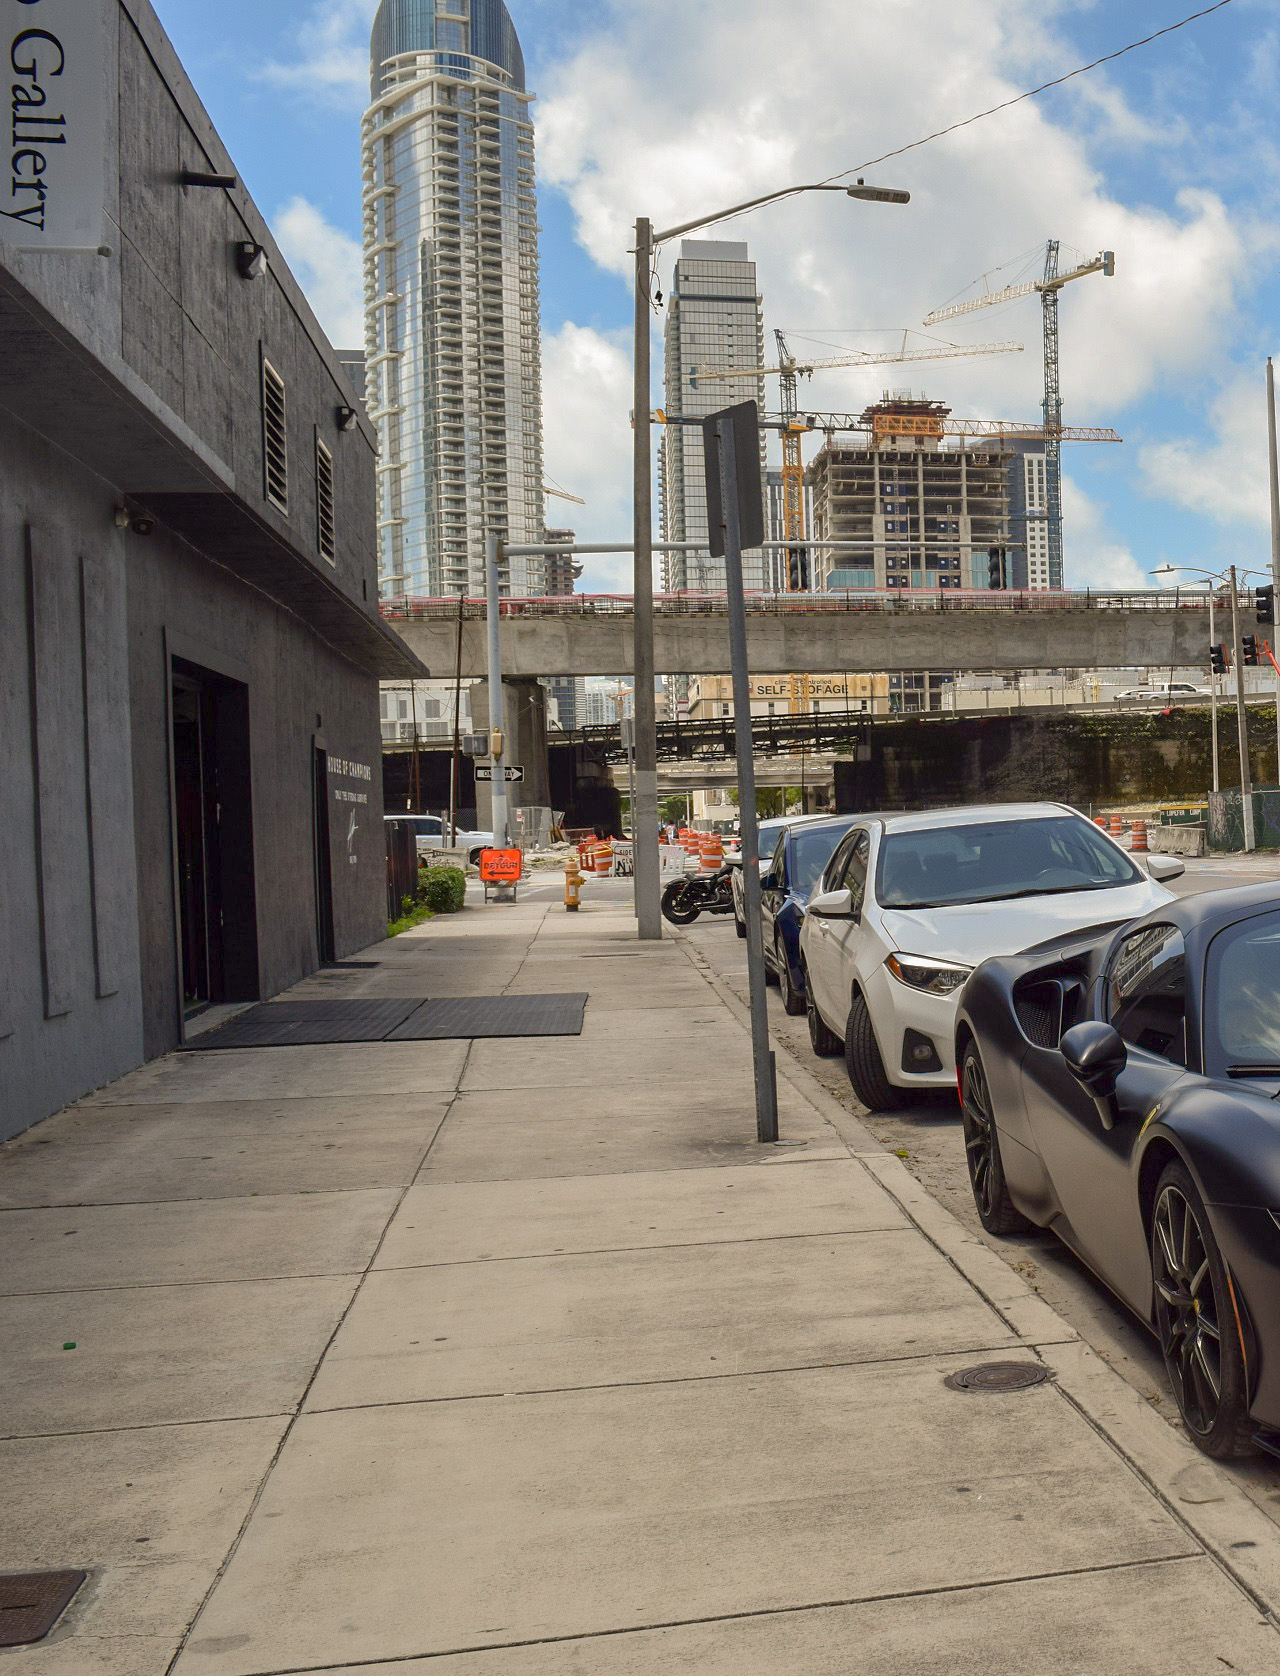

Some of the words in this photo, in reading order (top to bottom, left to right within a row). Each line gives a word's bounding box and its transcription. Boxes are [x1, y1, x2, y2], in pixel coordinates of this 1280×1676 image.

[0, 28, 67, 232] Gallery
[328, 756, 342, 774] HOUSE
[342, 760, 348, 775] OF
[349, 761, 371, 781] CHAMPIONS
